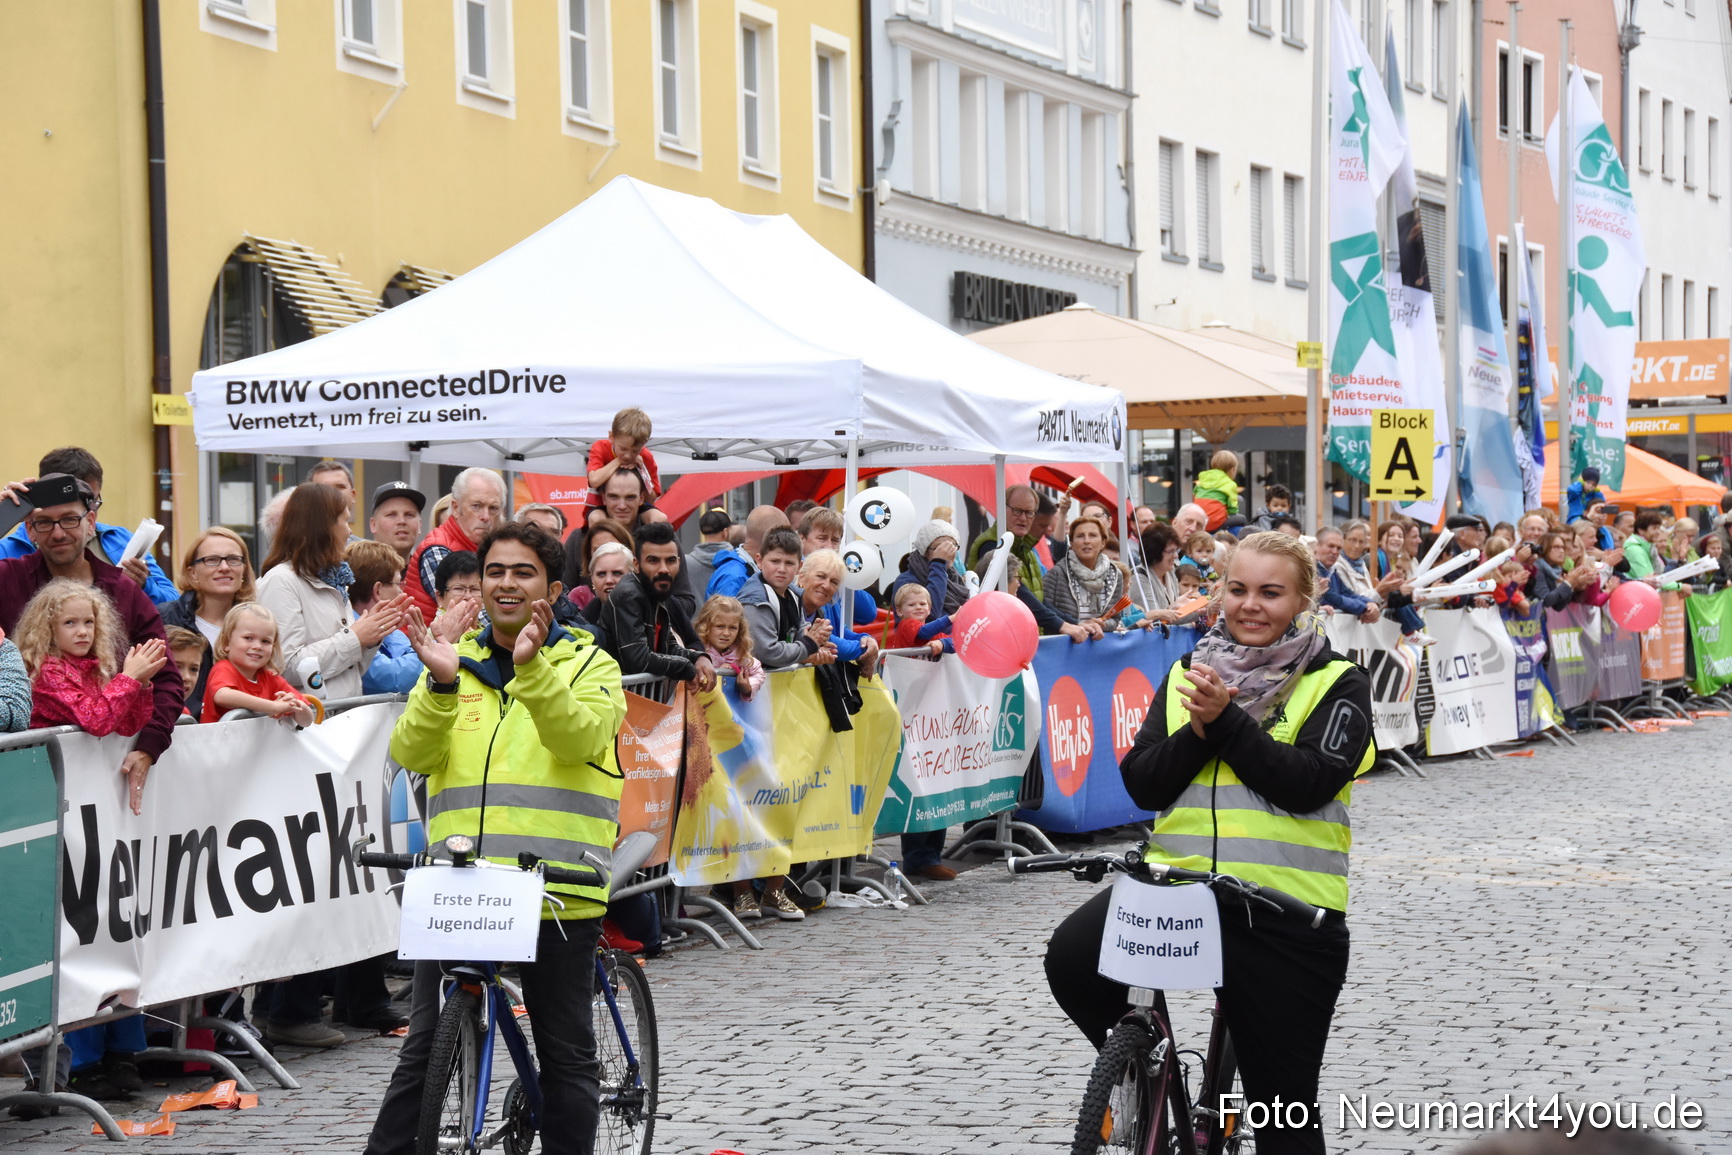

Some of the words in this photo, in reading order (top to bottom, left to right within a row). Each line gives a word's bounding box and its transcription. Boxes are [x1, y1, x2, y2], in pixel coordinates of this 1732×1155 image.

[963, 271, 1023, 325] BRILLEN
[226, 380, 312, 405] BMW
[318, 367, 567, 403] ConnectedDrive
[1331, 373, 1402, 389] Gebäudere
[1332, 389, 1404, 405] Mietservice
[227, 411, 324, 431] Vernetzt,
[330, 411, 362, 427] um
[368, 406, 402, 425] frei
[407, 410, 431, 424] zu
[437, 403, 488, 422] sein.
[1037, 409, 1070, 442] PARTL
[1070, 409, 1110, 444] Neumarkt
[1380, 412, 1428, 430] Block
[1384, 437, 1420, 481] A
[622, 733, 635, 746] für
[1048, 703, 1092, 772] Hervis
[62, 772, 375, 946] Neumarkt
[433, 893, 473, 907] Erste
[477, 893, 512, 907] Frau
[427, 917, 515, 933] Jugendlauf
[1117, 906, 1152, 929] Erster
[1156, 916, 1204, 931] Mann
[1116, 934, 1200, 958] Jugendlauf
